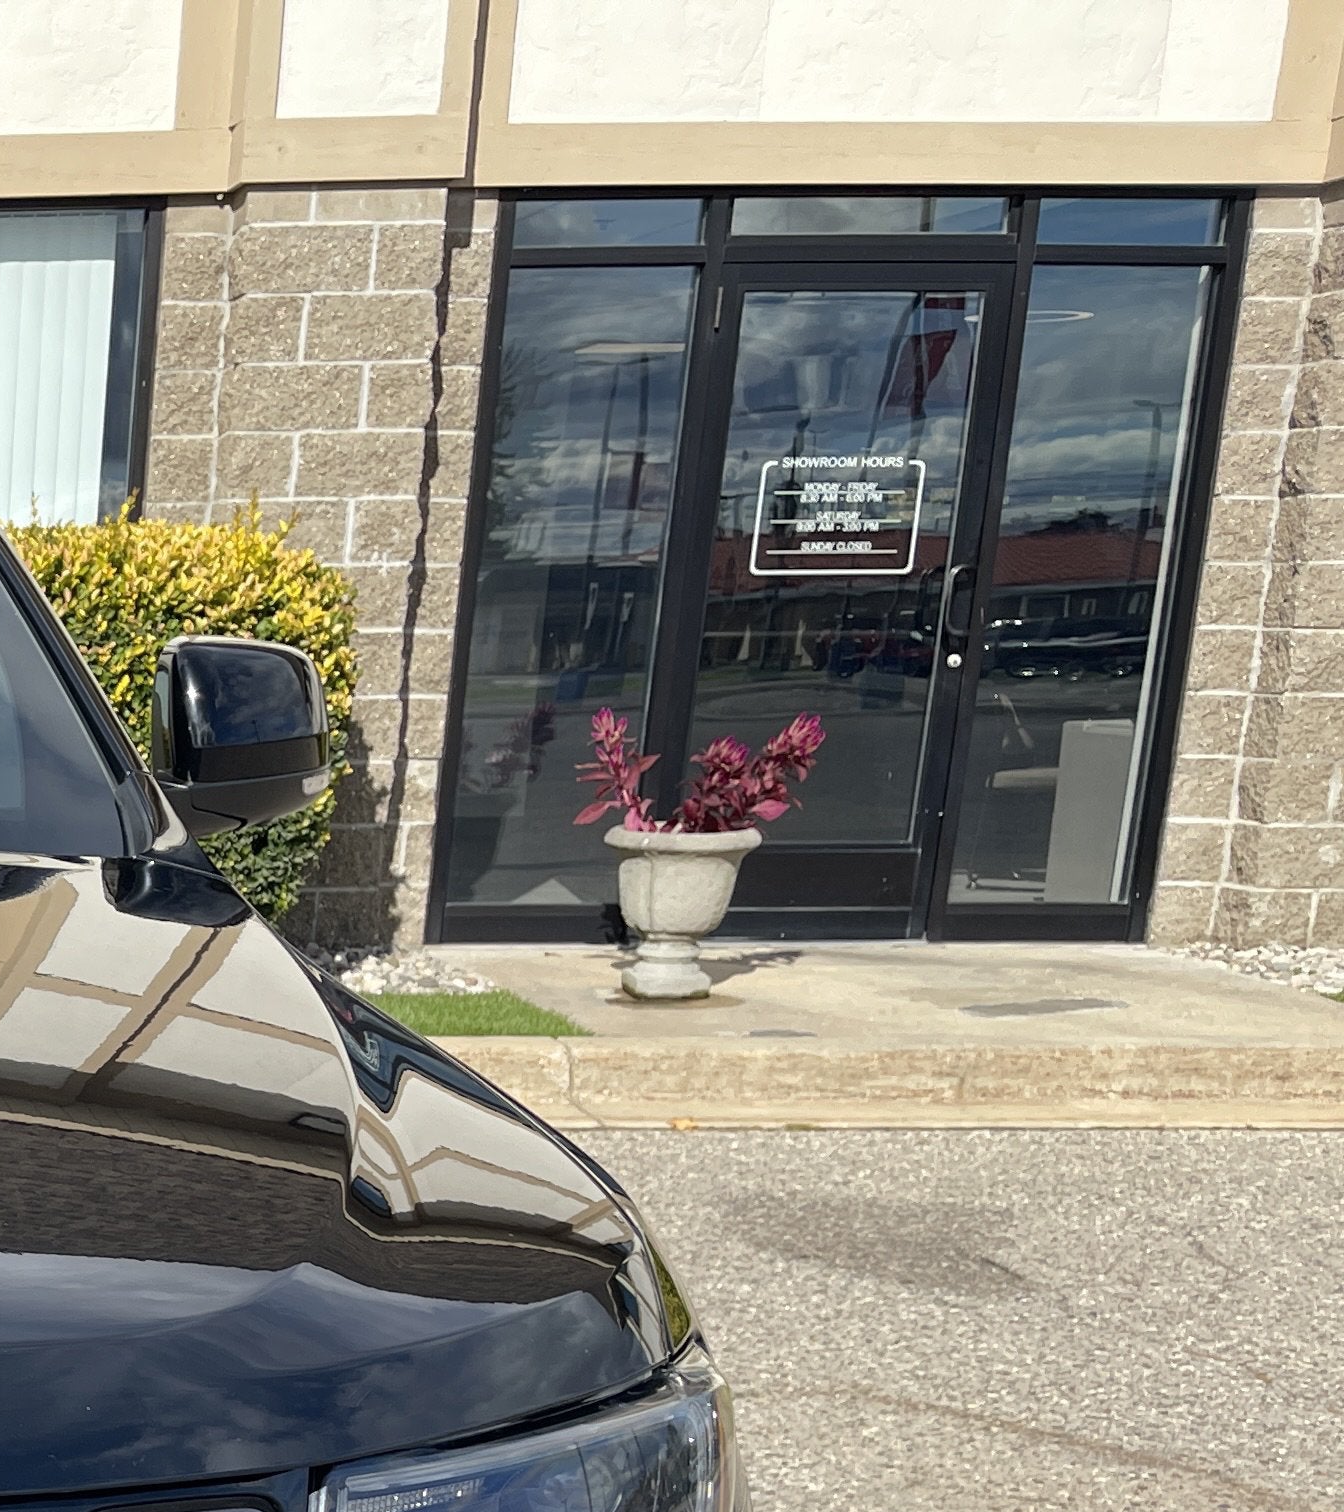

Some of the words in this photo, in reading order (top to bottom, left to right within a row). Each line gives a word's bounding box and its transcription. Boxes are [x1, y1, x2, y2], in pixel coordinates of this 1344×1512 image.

[782, 456, 857, 468] SHOWROOM
[861, 456, 905, 468] HOURS
[804, 482, 841, 492] MONDAY
[847, 482, 879, 492] FRIDAY
[821, 492, 838, 503] AM
[867, 492, 883, 503] PM
[816, 511, 862, 521] SATURDAY
[817, 521, 835, 532] AM
[863, 521, 880, 532] PM
[800, 541, 835, 551] SUNDAY
[836, 541, 872, 551] CLOSED
